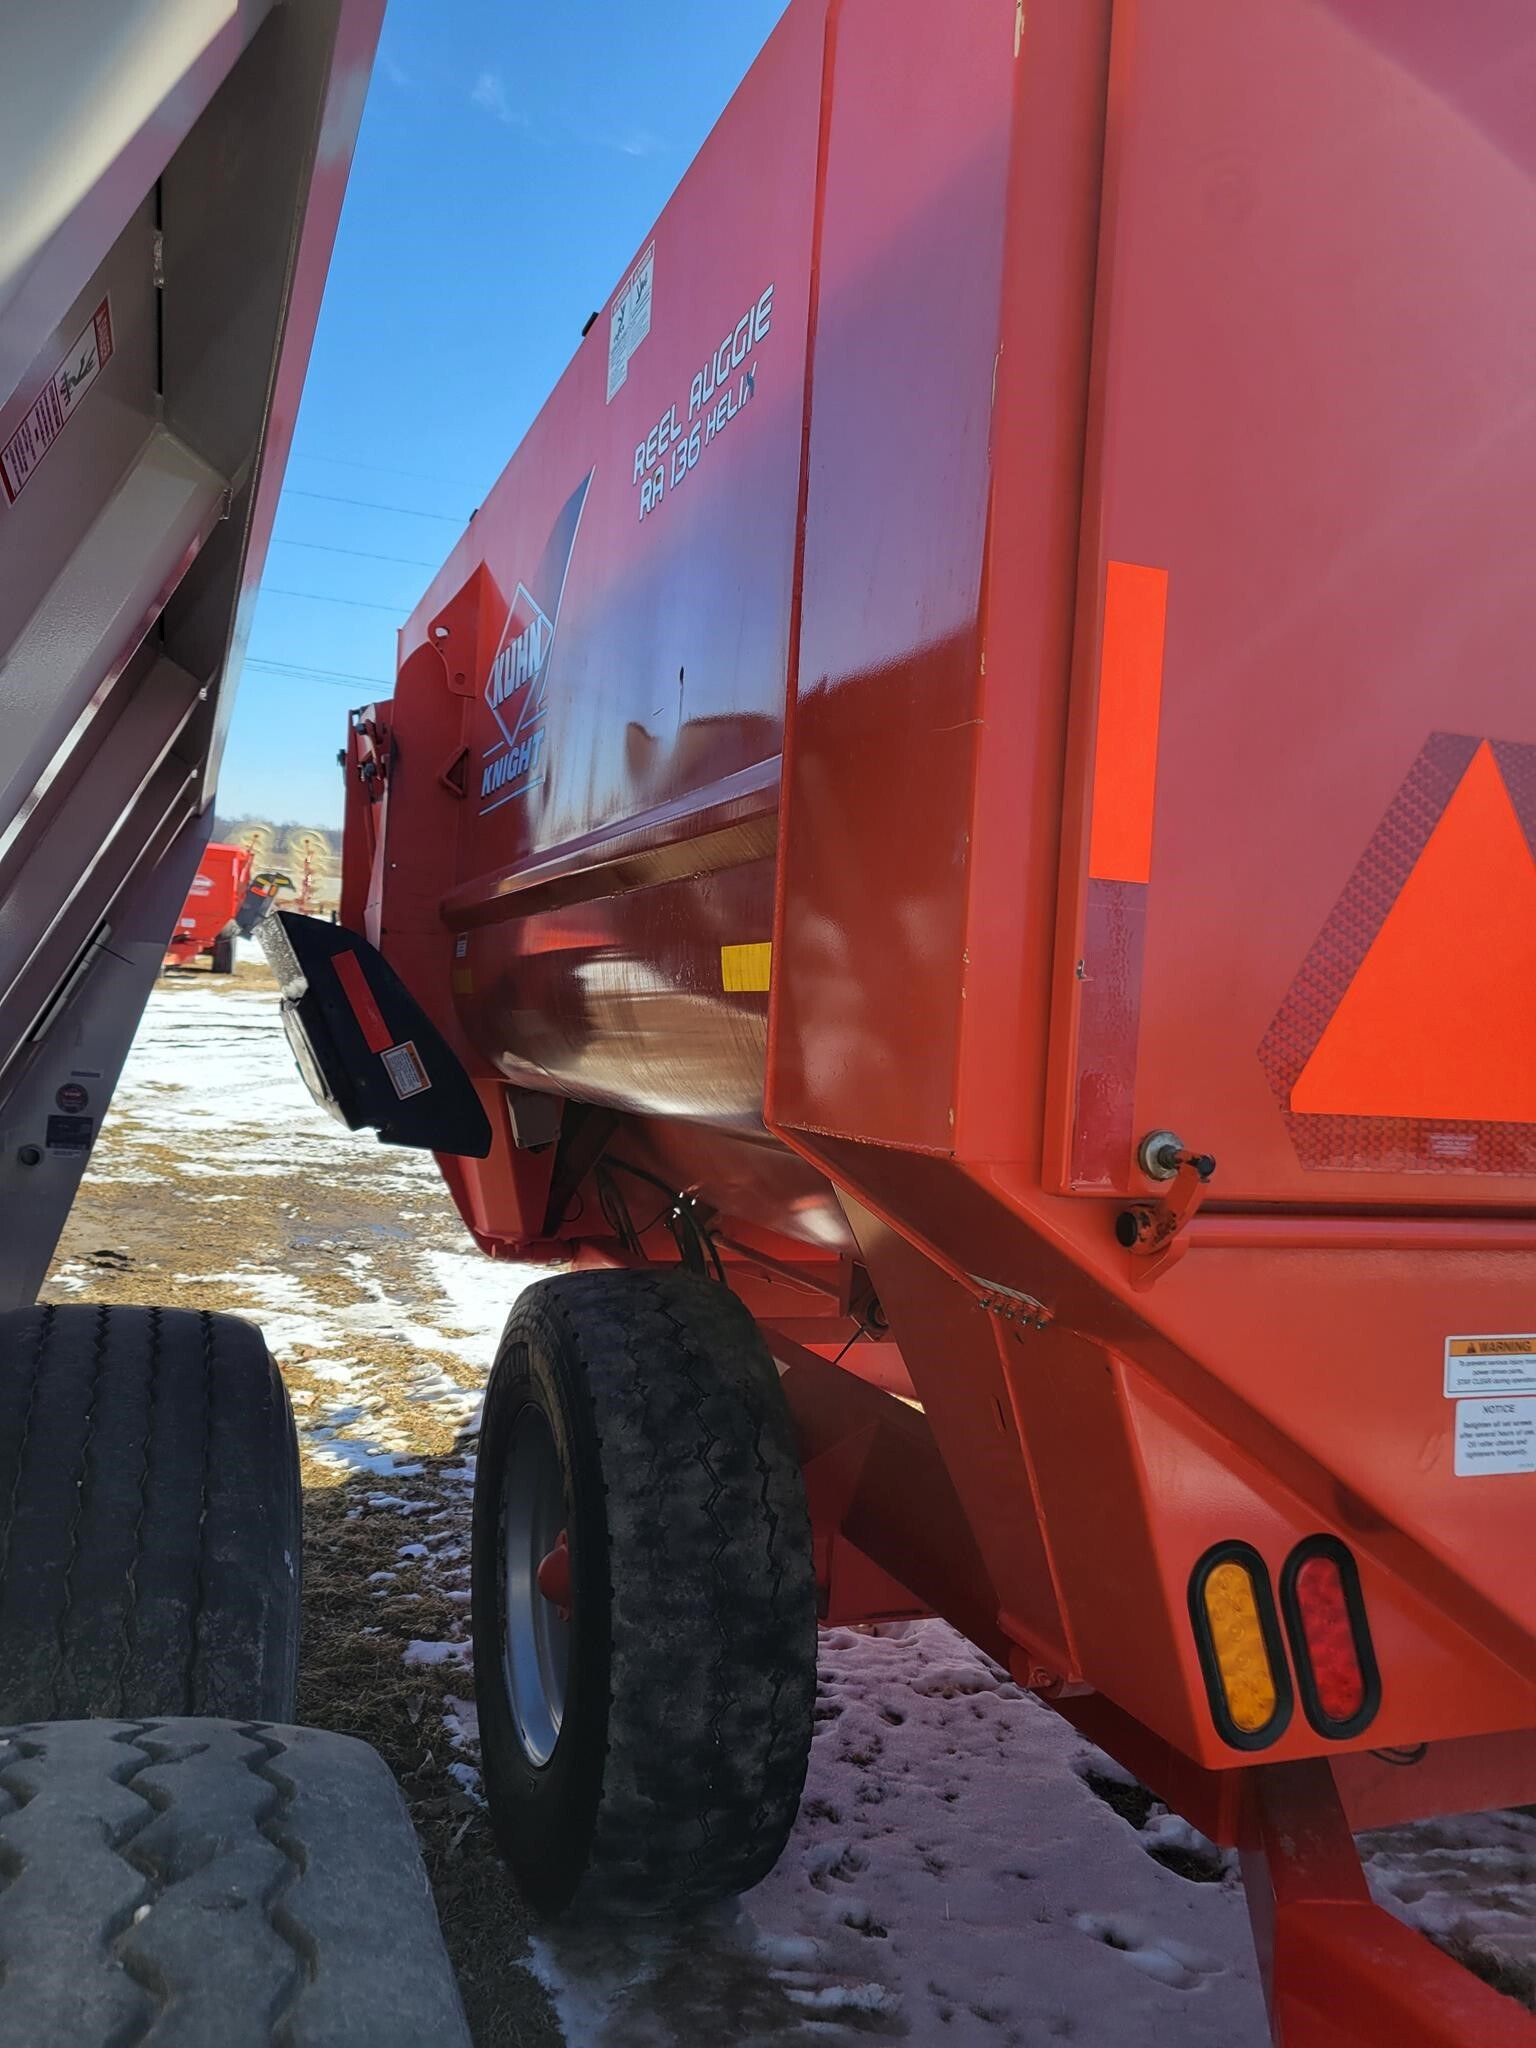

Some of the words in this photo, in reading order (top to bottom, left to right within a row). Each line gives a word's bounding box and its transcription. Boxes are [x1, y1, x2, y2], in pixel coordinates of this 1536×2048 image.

[633, 403, 683, 486] REEL
[687, 282, 774, 422] AUGGIE
[638, 464, 664, 522] RA
[670, 419, 702, 490] 136
[492, 613, 543, 711] KUHN
[480, 727, 545, 799] KNIGHT
[1478, 1340, 1533, 1354] WARNING
[1482, 1404, 1516, 1415] NOTICE
